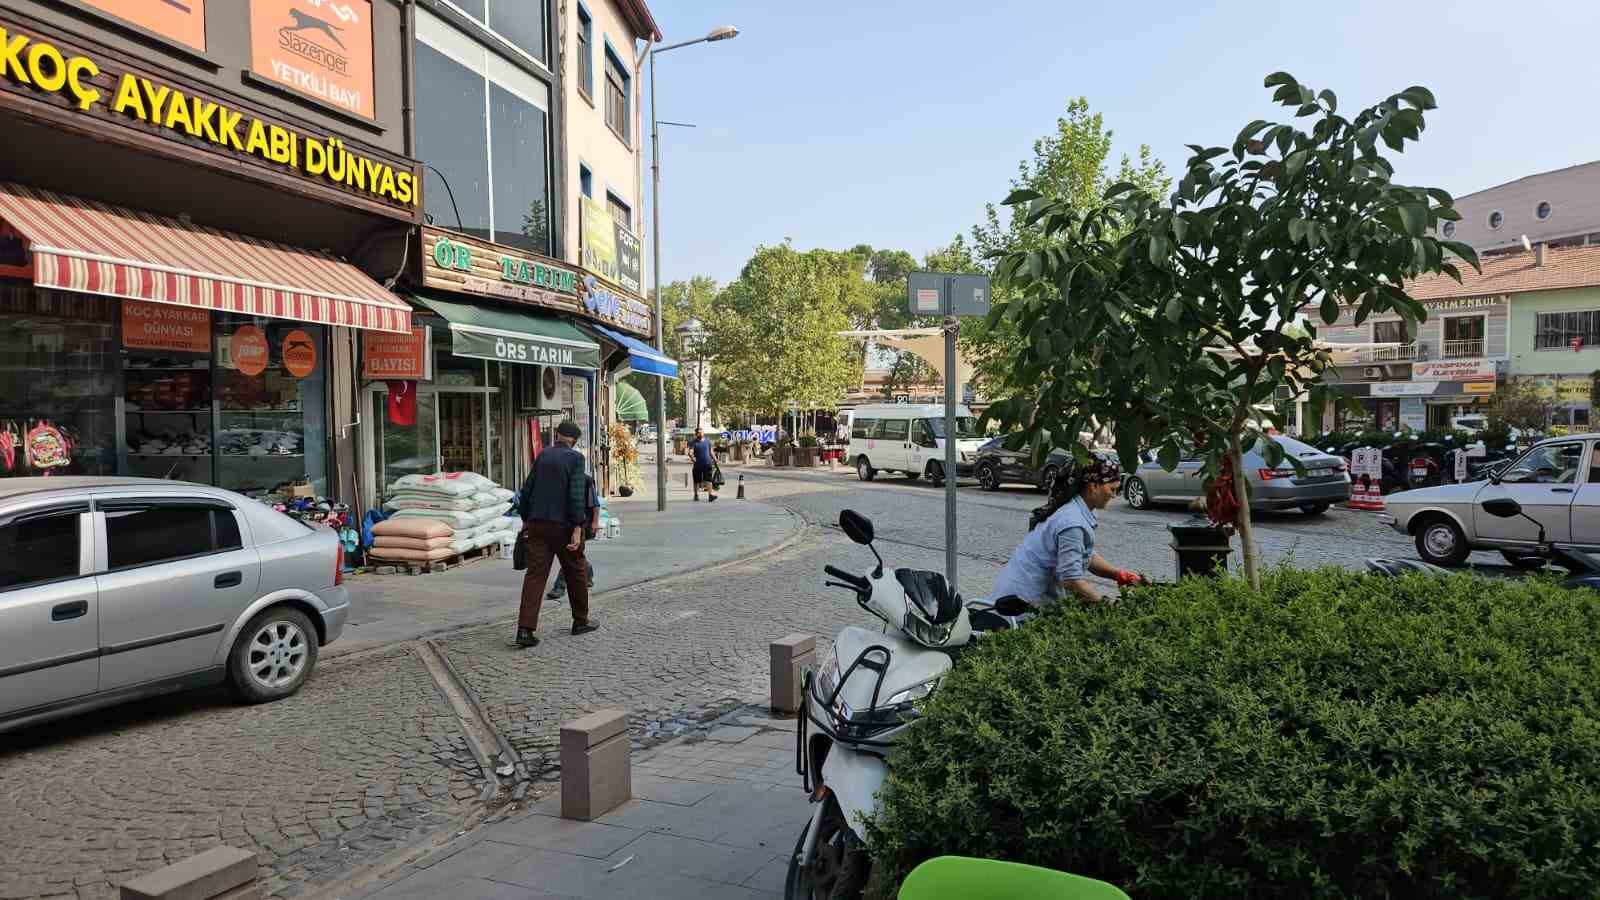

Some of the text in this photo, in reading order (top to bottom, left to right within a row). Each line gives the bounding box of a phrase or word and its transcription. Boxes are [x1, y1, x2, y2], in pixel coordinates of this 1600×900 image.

[277, 27, 348, 73] Slazenger
[271, 59, 361, 110] YETKİLİ BAYİ
[0, 26, 418, 205] KOÇ AYAKKABI DÜNYASI
[433, 236, 472, 272] ÖR
[500, 255, 578, 293] TARIM
[126, 304, 208, 321] KOÇ AYAKKABI
[143, 320, 193, 337] DÜNYASI
[495, 338, 573, 365] ÖRS TARIM
